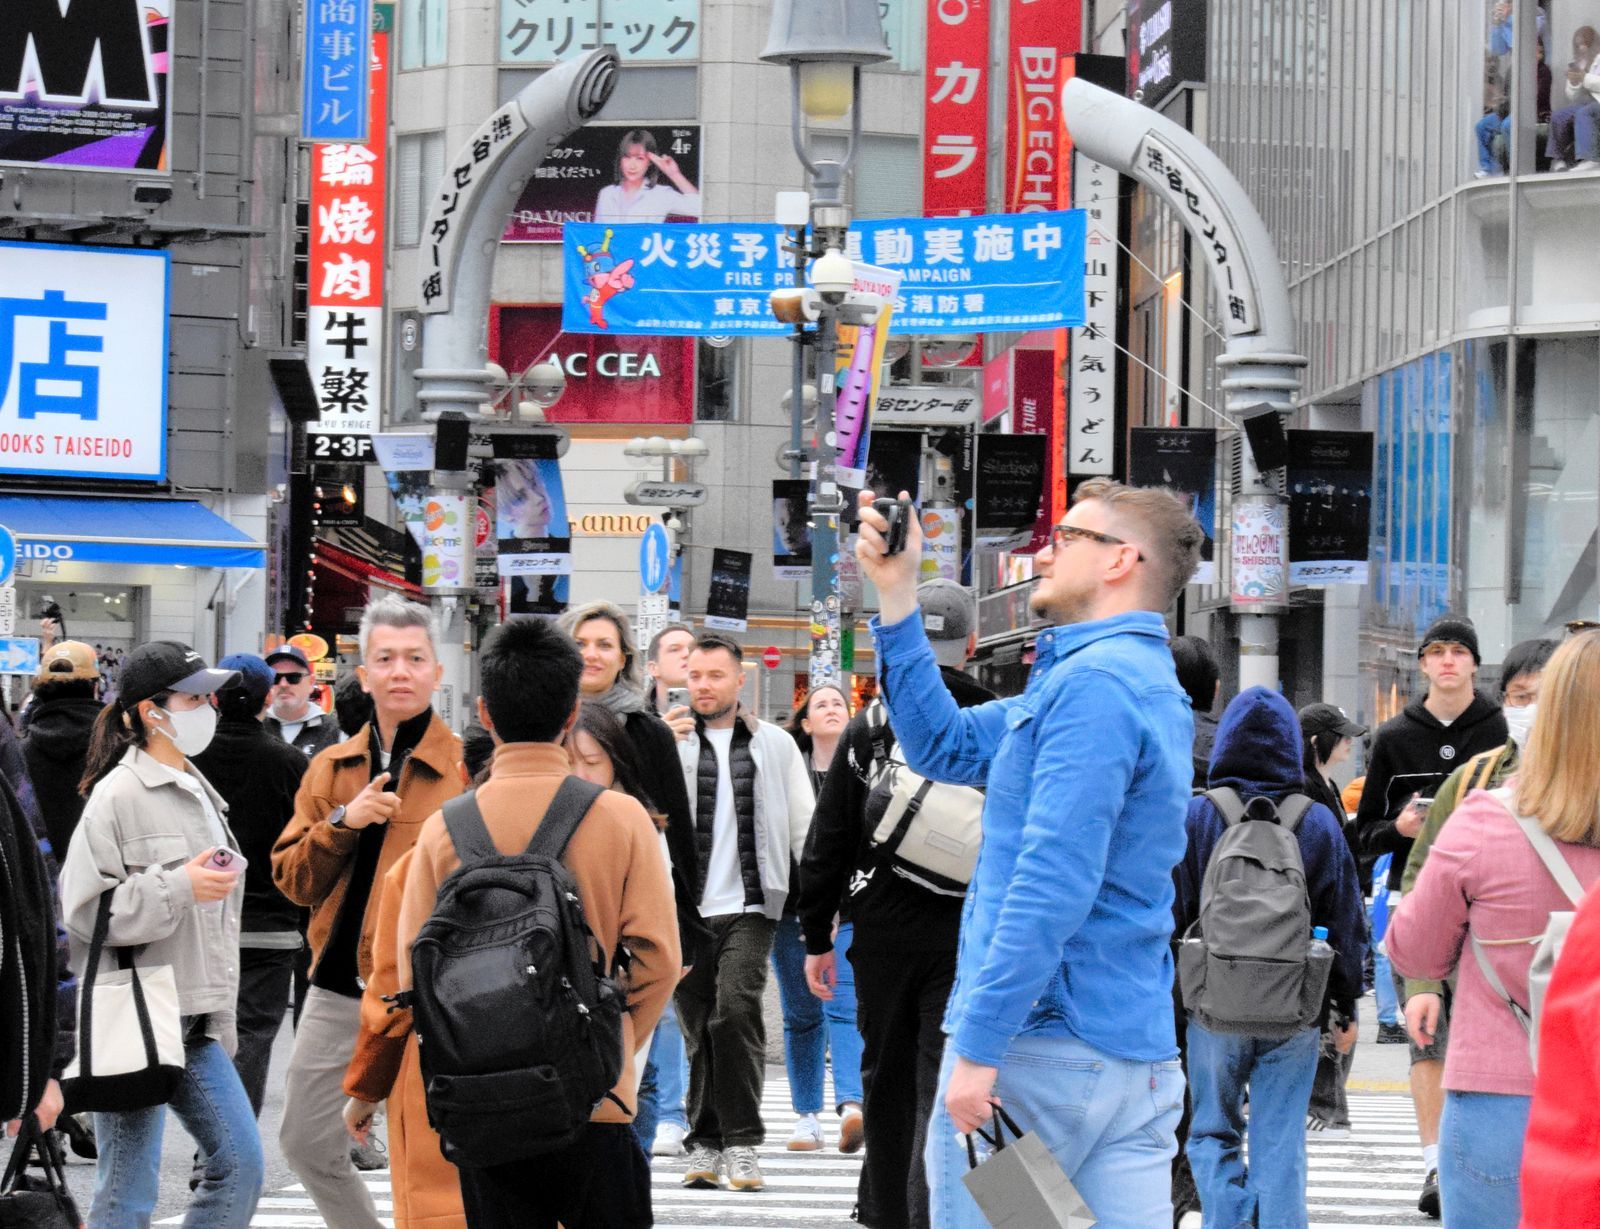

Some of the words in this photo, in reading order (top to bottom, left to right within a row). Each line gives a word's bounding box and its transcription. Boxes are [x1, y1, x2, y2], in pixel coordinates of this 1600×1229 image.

[506, 15, 696, 56] クリニック
[317, 0, 356, 124] 商事ビル
[1019, 47, 1056, 121] BIG
[671, 138, 692, 154] 4F
[930, 61, 980, 218] カラ
[318, 145, 377, 300] 輪焼肉
[422, 114, 512, 305] 渋谷センター街
[545, 210, 592, 224] VINCI
[1147, 147, 1246, 324] 渋谷センター街
[725, 272, 762, 286] FIRE
[900, 268, 971, 283] AMPAIGN
[318, 306, 371, 413] 牛繁
[596, 353, 661, 377] CEA
[1079, 259, 1109, 463] 山下本気うどん
[876, 398, 974, 413] 谷センター街
[0, 433, 44, 454] OOKS
[54, 435, 132, 458] TAISEIDO
[1234, 534, 1280, 555] WELCOME
[1241, 555, 1282, 566] SHIBUYA
